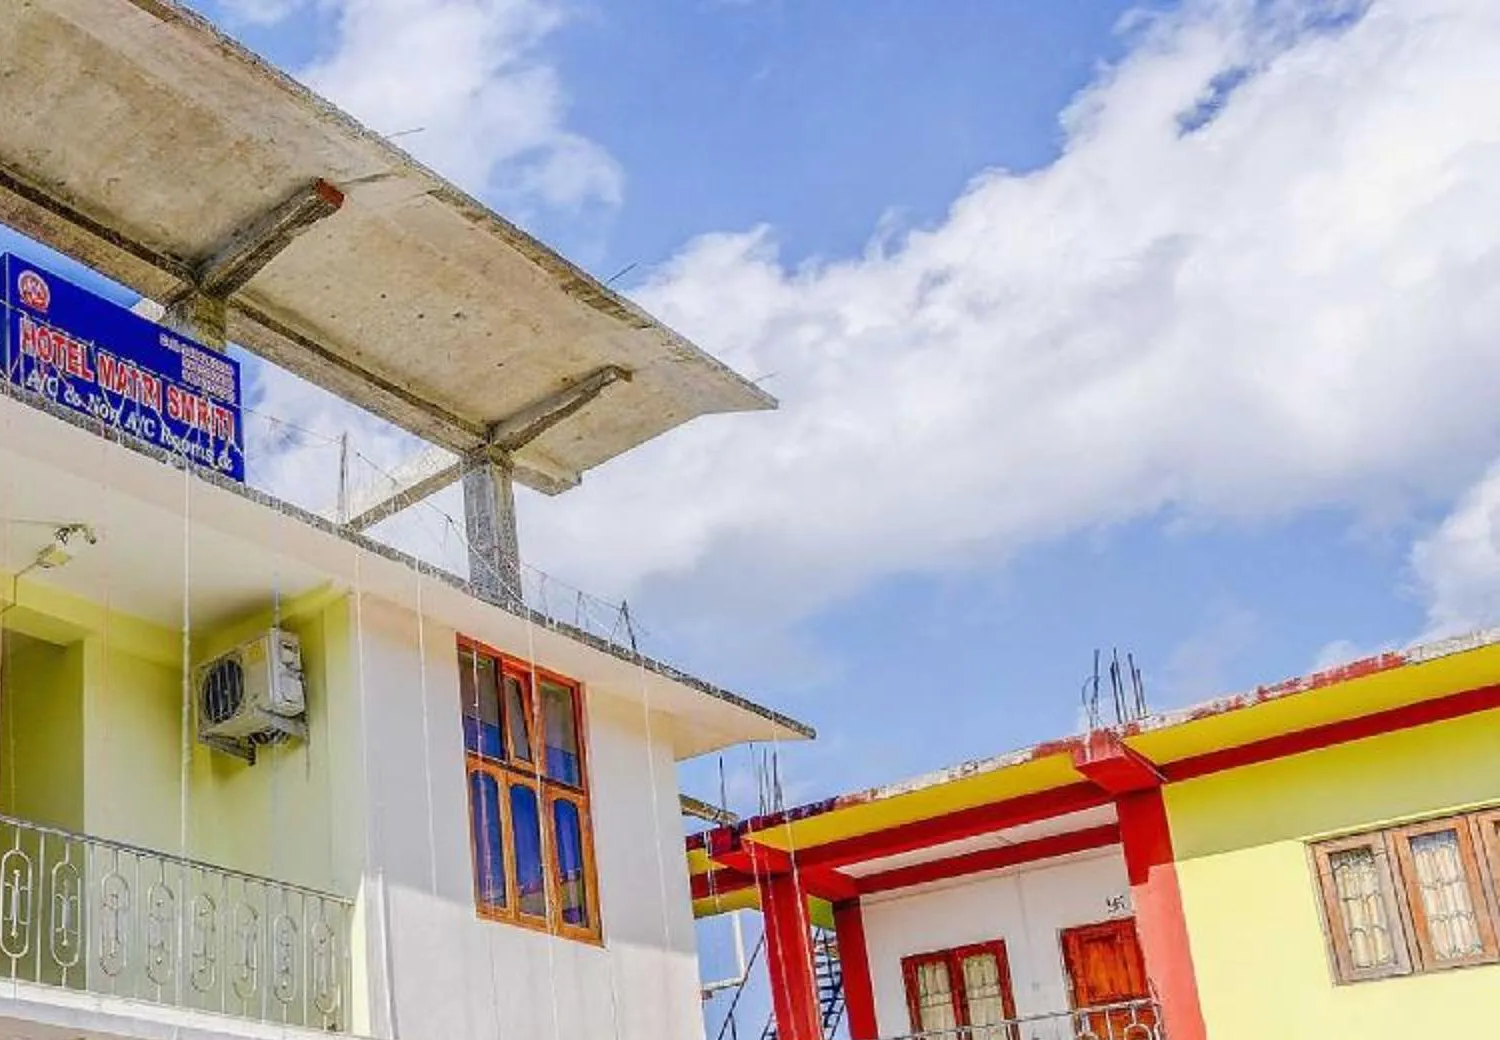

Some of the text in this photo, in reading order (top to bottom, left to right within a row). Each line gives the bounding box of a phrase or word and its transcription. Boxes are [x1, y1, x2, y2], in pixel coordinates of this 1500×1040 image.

[19, 318, 95, 383] HOTEL
[97, 351, 163, 414] MATRI
[167, 385, 235, 443] SMRITI
[126, 412, 156, 438] A/C
